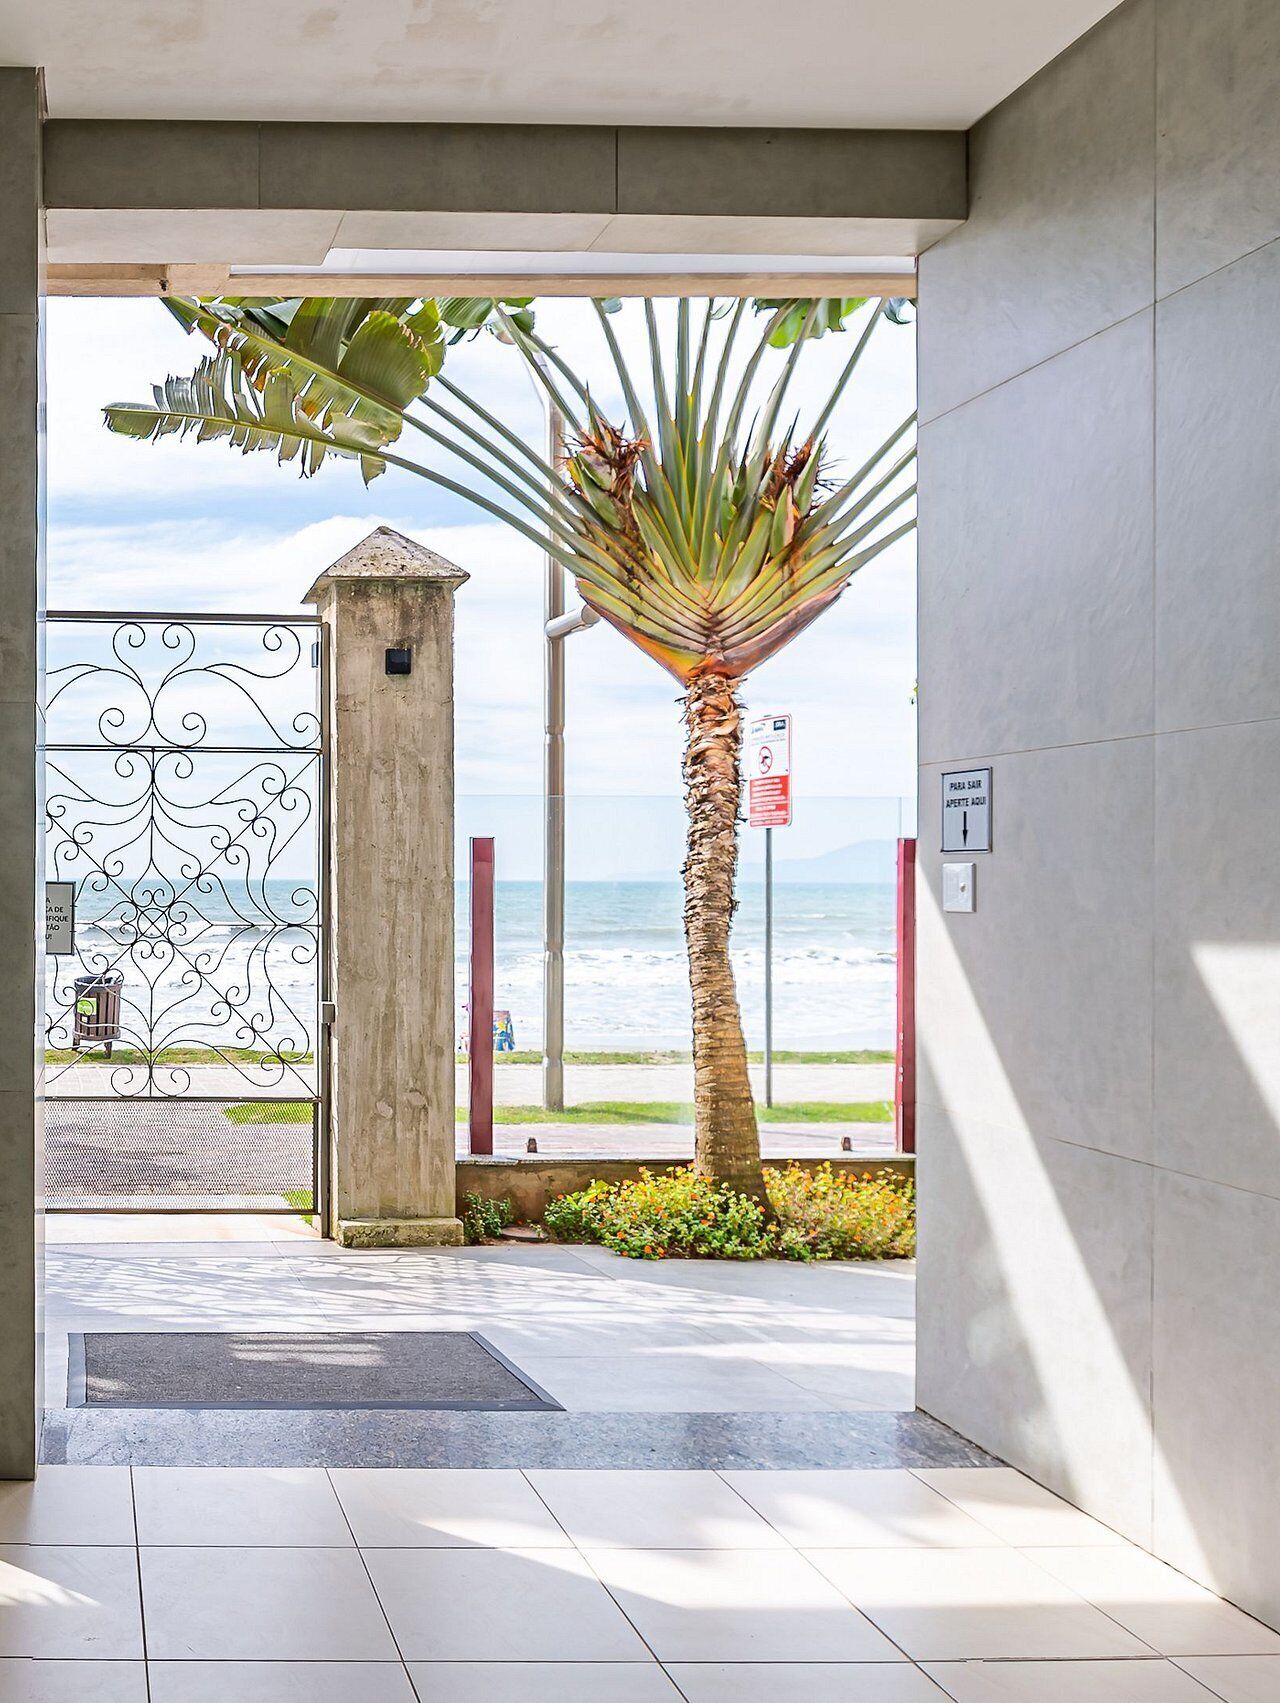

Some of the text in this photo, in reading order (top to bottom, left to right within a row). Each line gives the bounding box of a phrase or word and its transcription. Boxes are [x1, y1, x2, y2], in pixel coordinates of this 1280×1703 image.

[949, 780, 982, 791] PARA SAIR
[946, 796, 986, 808] APERTE AQUI
